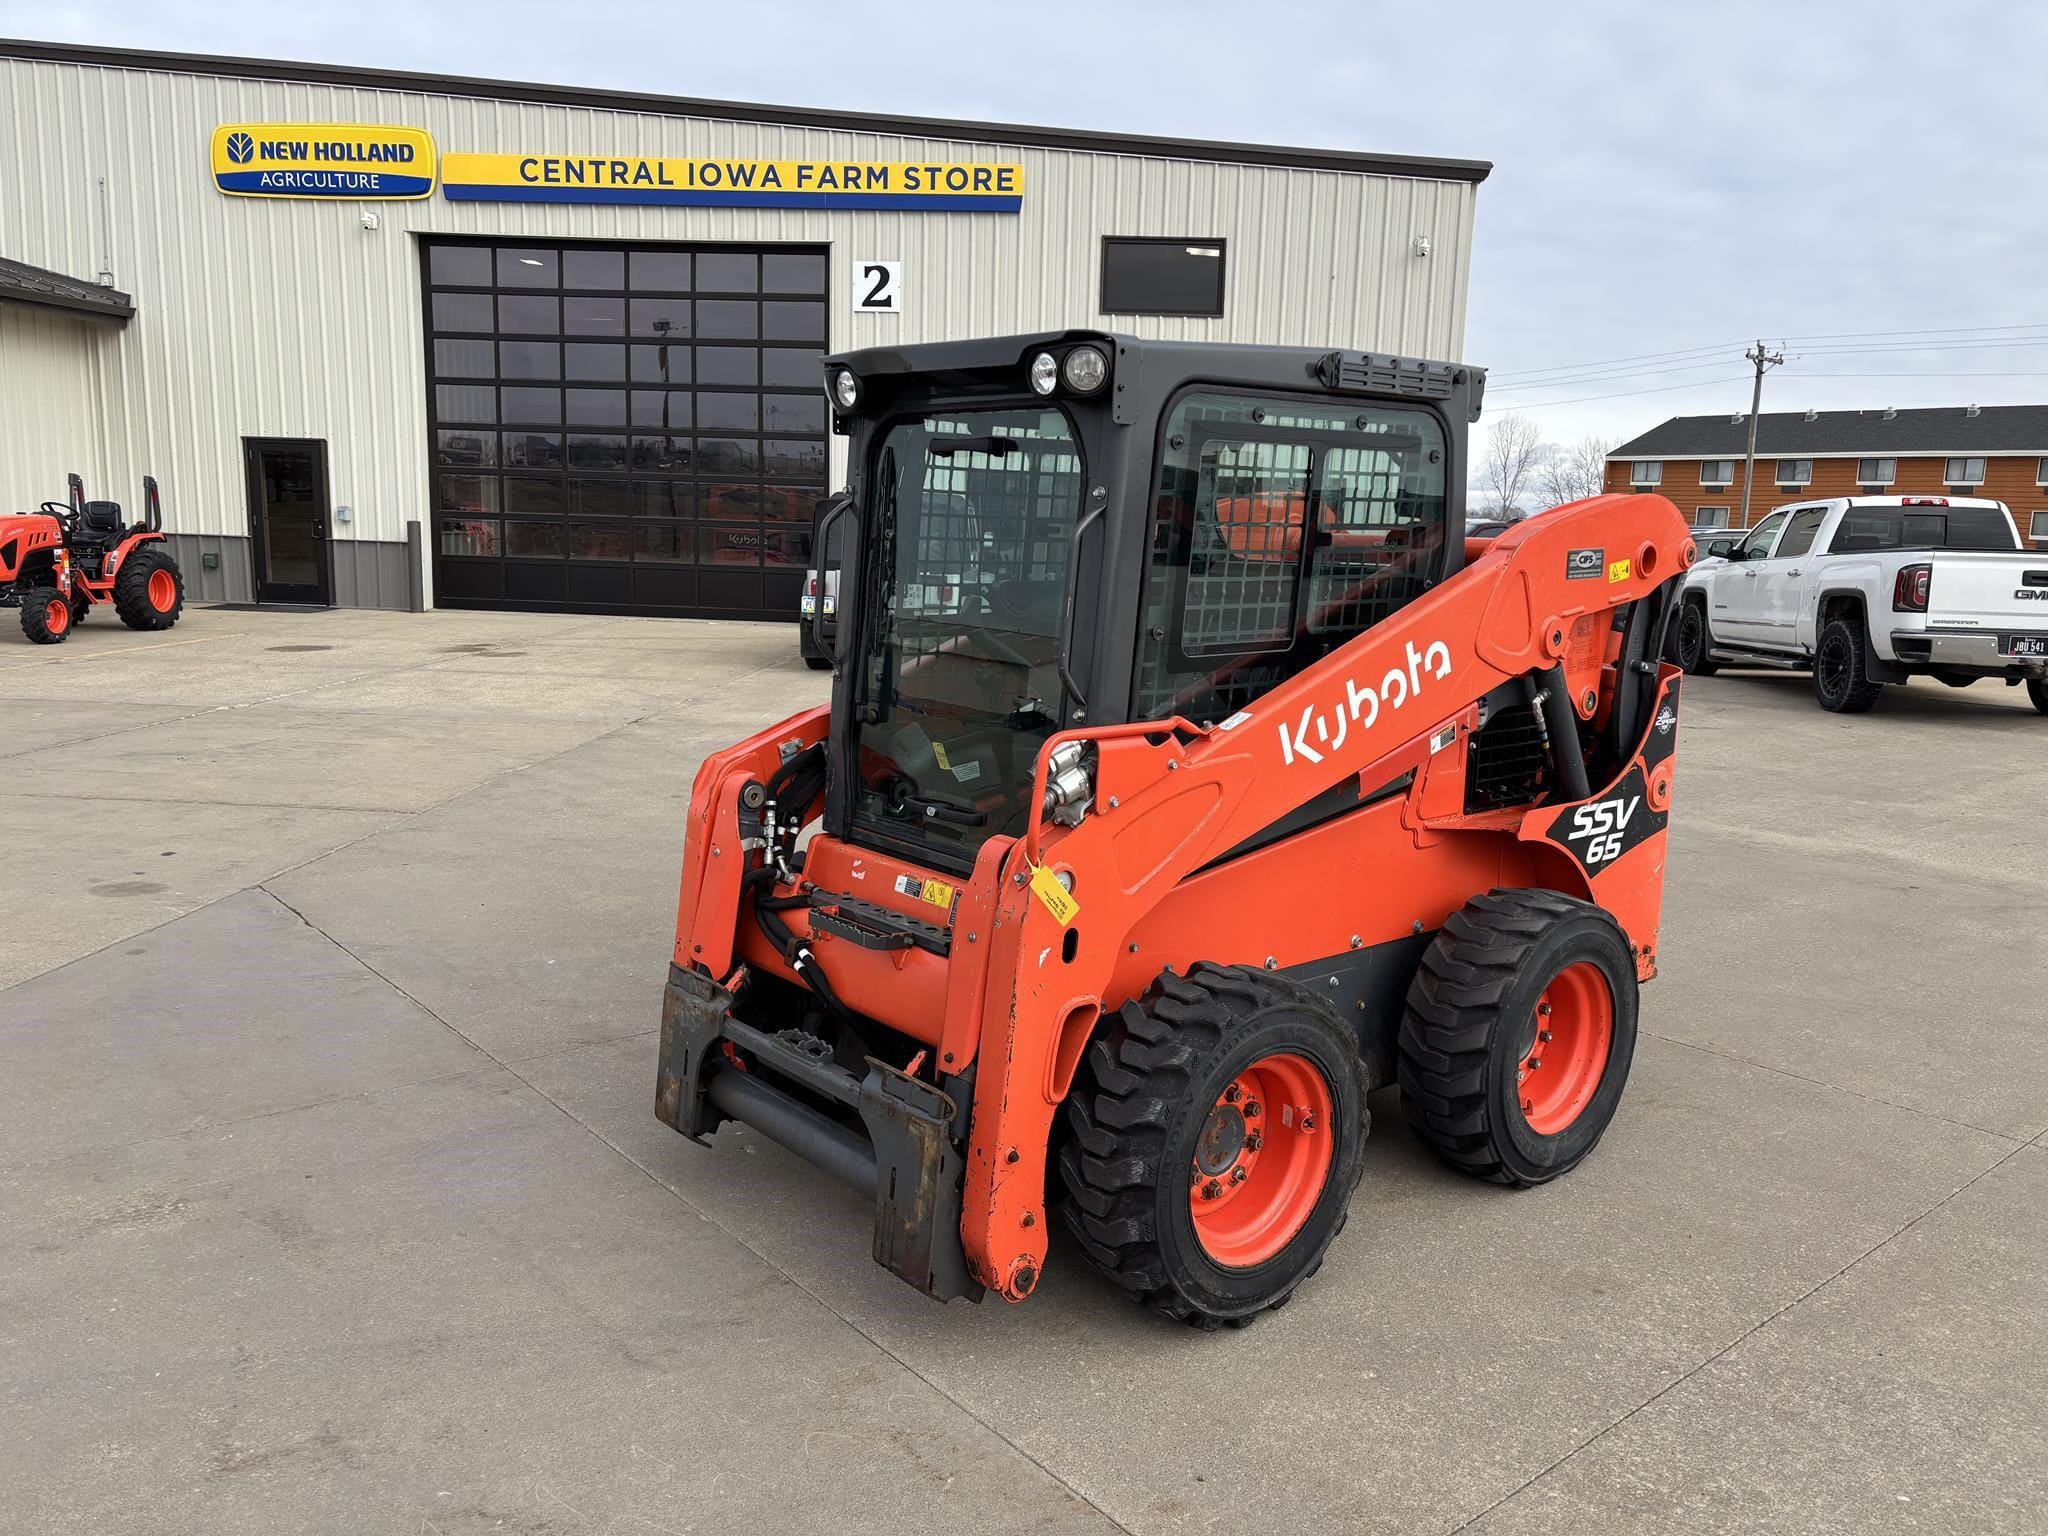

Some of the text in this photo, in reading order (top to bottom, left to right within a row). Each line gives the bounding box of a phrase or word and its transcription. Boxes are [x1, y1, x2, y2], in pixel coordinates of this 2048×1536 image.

[260, 141, 415, 163] NEW HOLLAND
[260, 172, 380, 190] AGRICULTURE
[519, 158, 1014, 191] CENTRAL IOWA FARM STORE
[862, 265, 892, 307] 2
[2014, 590, 2048, 600] GM
[2014, 641, 2044, 652] JBU 541
[1278, 640, 1452, 766] Kubota
[1568, 795, 1641, 840] SSV
[1586, 831, 1624, 864] 65
